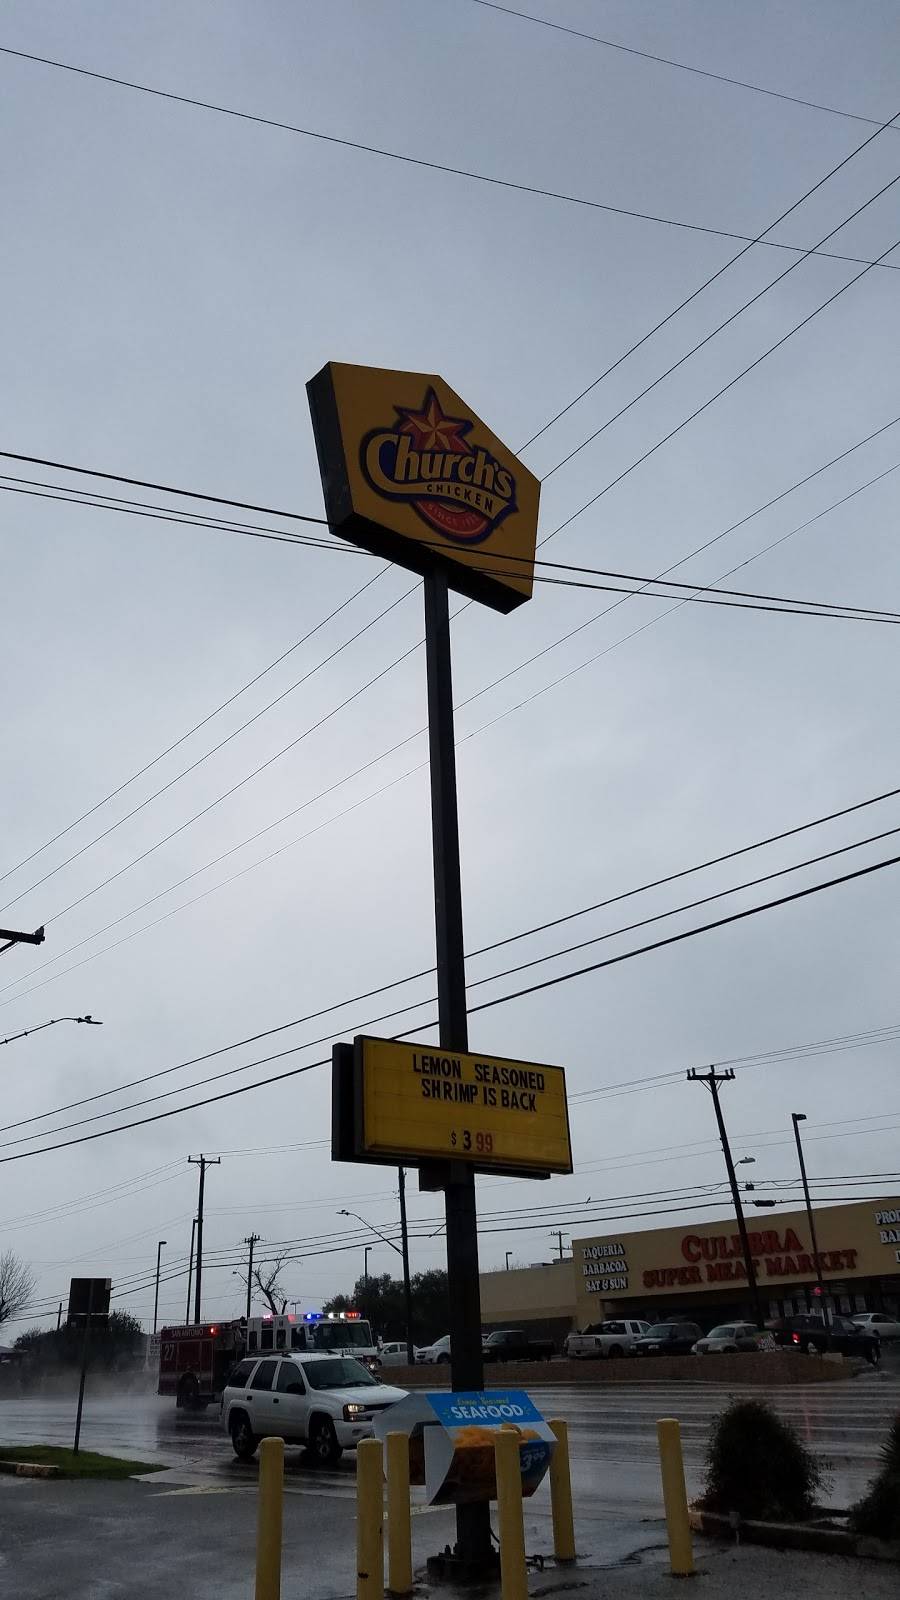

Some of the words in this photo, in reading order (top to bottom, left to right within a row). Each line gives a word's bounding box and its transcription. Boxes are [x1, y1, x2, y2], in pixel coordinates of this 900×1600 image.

[366, 432, 513, 499] Church's
[426, 483, 494, 513] CHICKEN
[412, 1053, 462, 1079] LEMON
[474, 1063, 545, 1091] SEASONED
[421, 1078, 478, 1104] SHRIMP
[483, 1086, 497, 1107] IS
[501, 1089, 537, 1112] BACK
[582, 1243, 625, 1260] TAQUERIA
[582, 1260, 629, 1276] BARBACOA
[642, 1265, 703, 1288] SUPER
[765, 1249, 858, 1277] MARKET
[586, 1279, 601, 1293] SAT
[601, 1279, 610, 1291] &
[609, 1277, 629, 1290] SUN
[164, 1343, 175, 1361] 27
[450, 1404, 524, 1419] SEAFOOD
